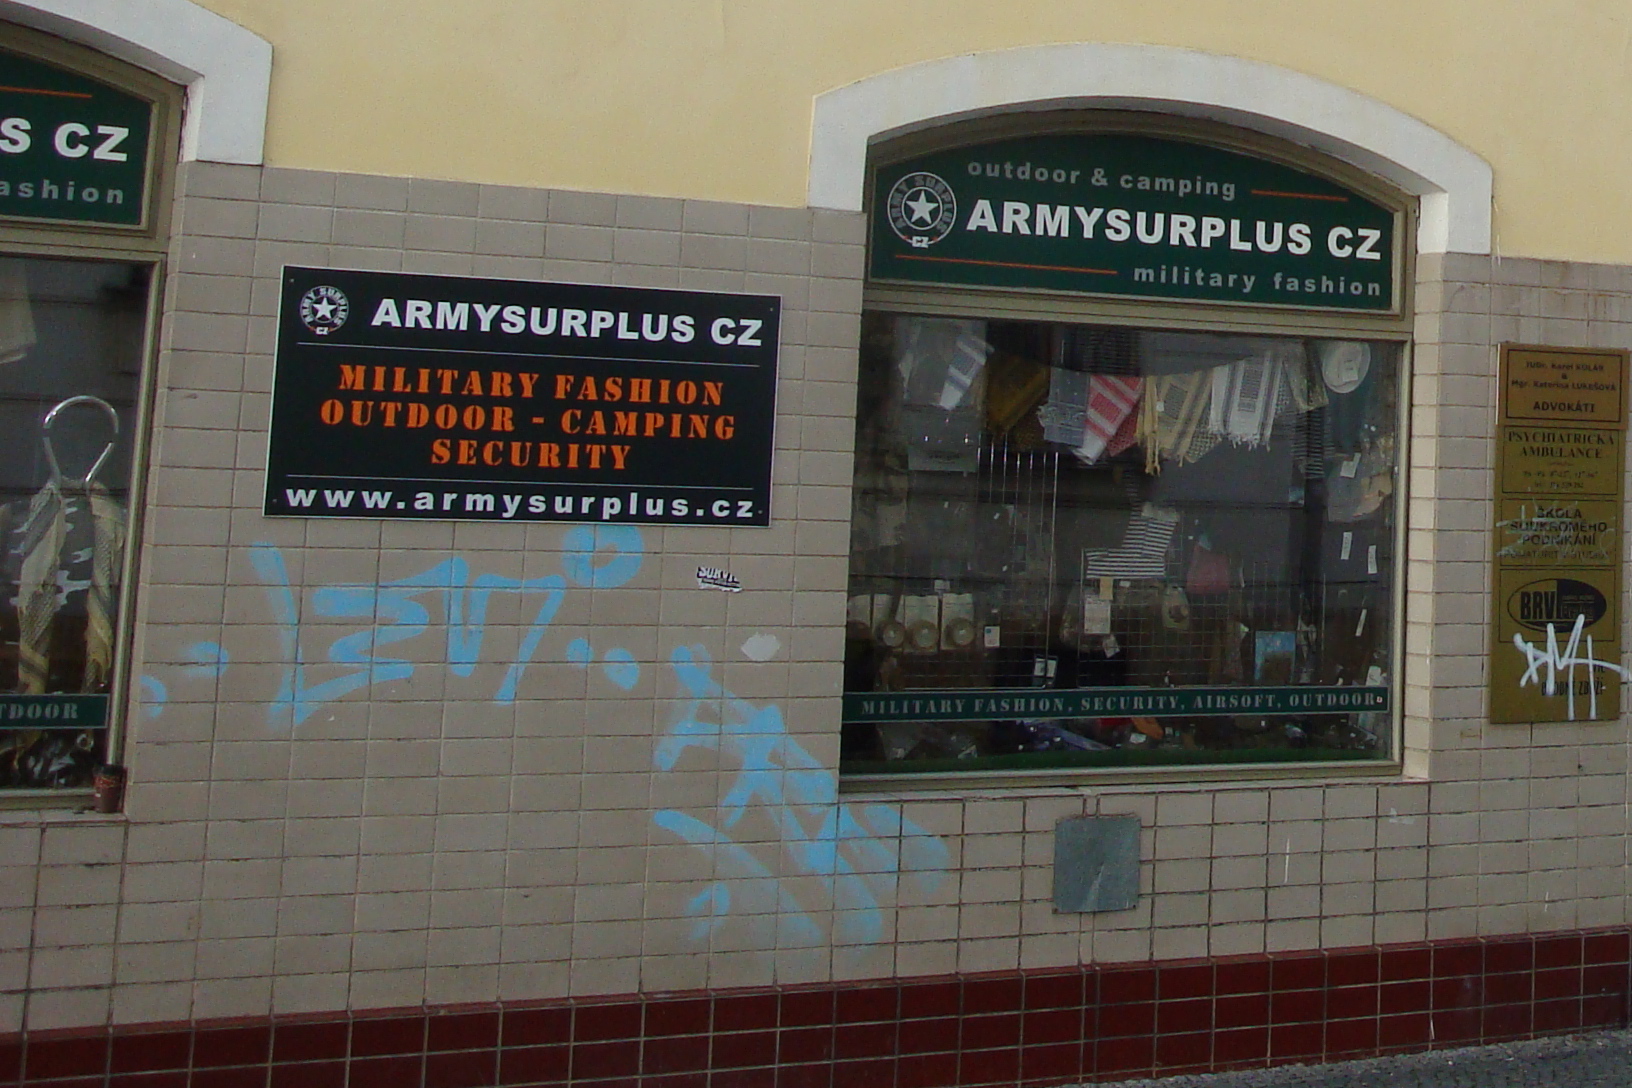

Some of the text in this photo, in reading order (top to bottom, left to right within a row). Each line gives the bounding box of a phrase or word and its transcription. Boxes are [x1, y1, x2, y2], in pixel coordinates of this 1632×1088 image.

[54, 123, 130, 162] CZ
[968, 160, 1236, 202] outdoor & camping
[966, 199, 1383, 261] ARMYSURPLUS CZ
[1133, 264, 1382, 297] military fashion
[372, 298, 764, 348] ARMYSURPLUS CZ
[339, 365, 724, 407] MILITARY FASHION
[320, 398, 516, 433] OUTDOOR
[561, 410, 737, 442] CAMPING
[1533, 400, 1596, 413] ADVOKÁTI
[431, 439, 632, 471] SECURITY
[1520, 446, 1603, 459] AMBULANCE
[286, 487, 754, 520] www.armysurplus.cz
[1520, 590, 1556, 620] BRV
[862, 691, 1375, 715] MILITARY FASHION, SECURITY, AIRSOFT, OUTDOOR
